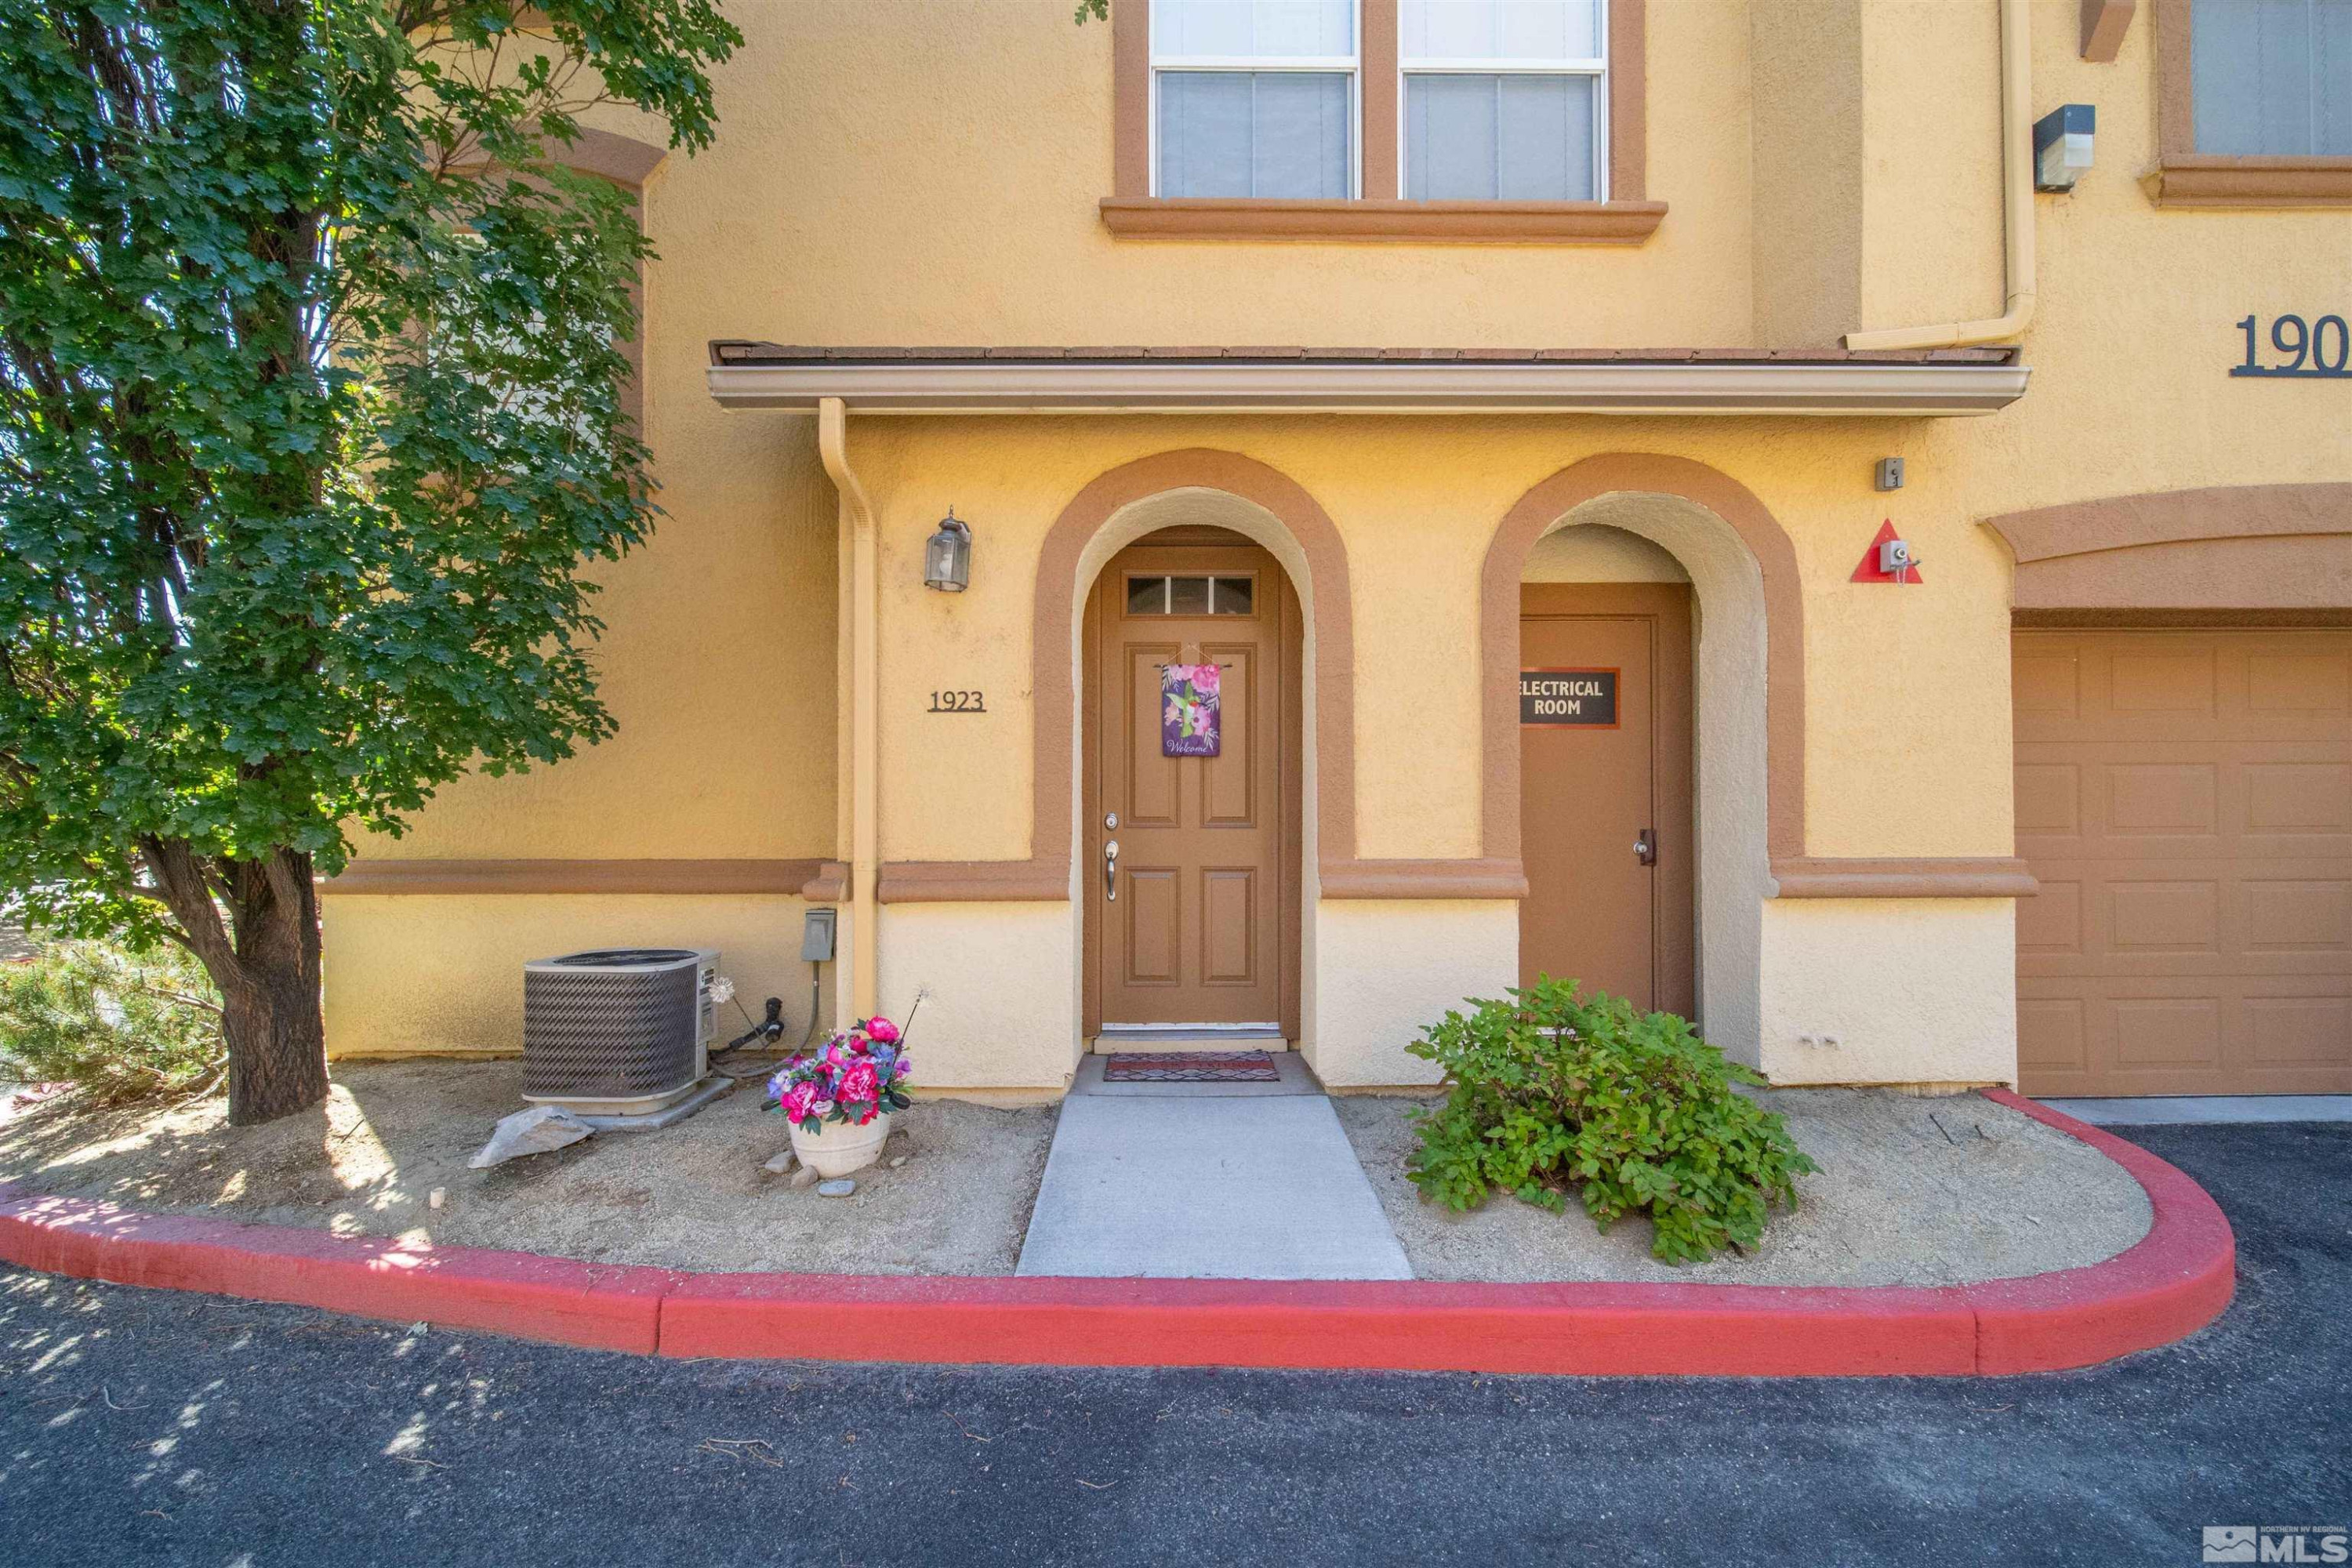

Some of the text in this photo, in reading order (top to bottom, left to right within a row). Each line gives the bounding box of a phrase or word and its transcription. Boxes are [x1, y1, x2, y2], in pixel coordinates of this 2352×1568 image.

[929, 691, 984, 712] 1923
[1534, 699, 1581, 714] ROOM
[1167, 739, 1207, 753] Welcome
